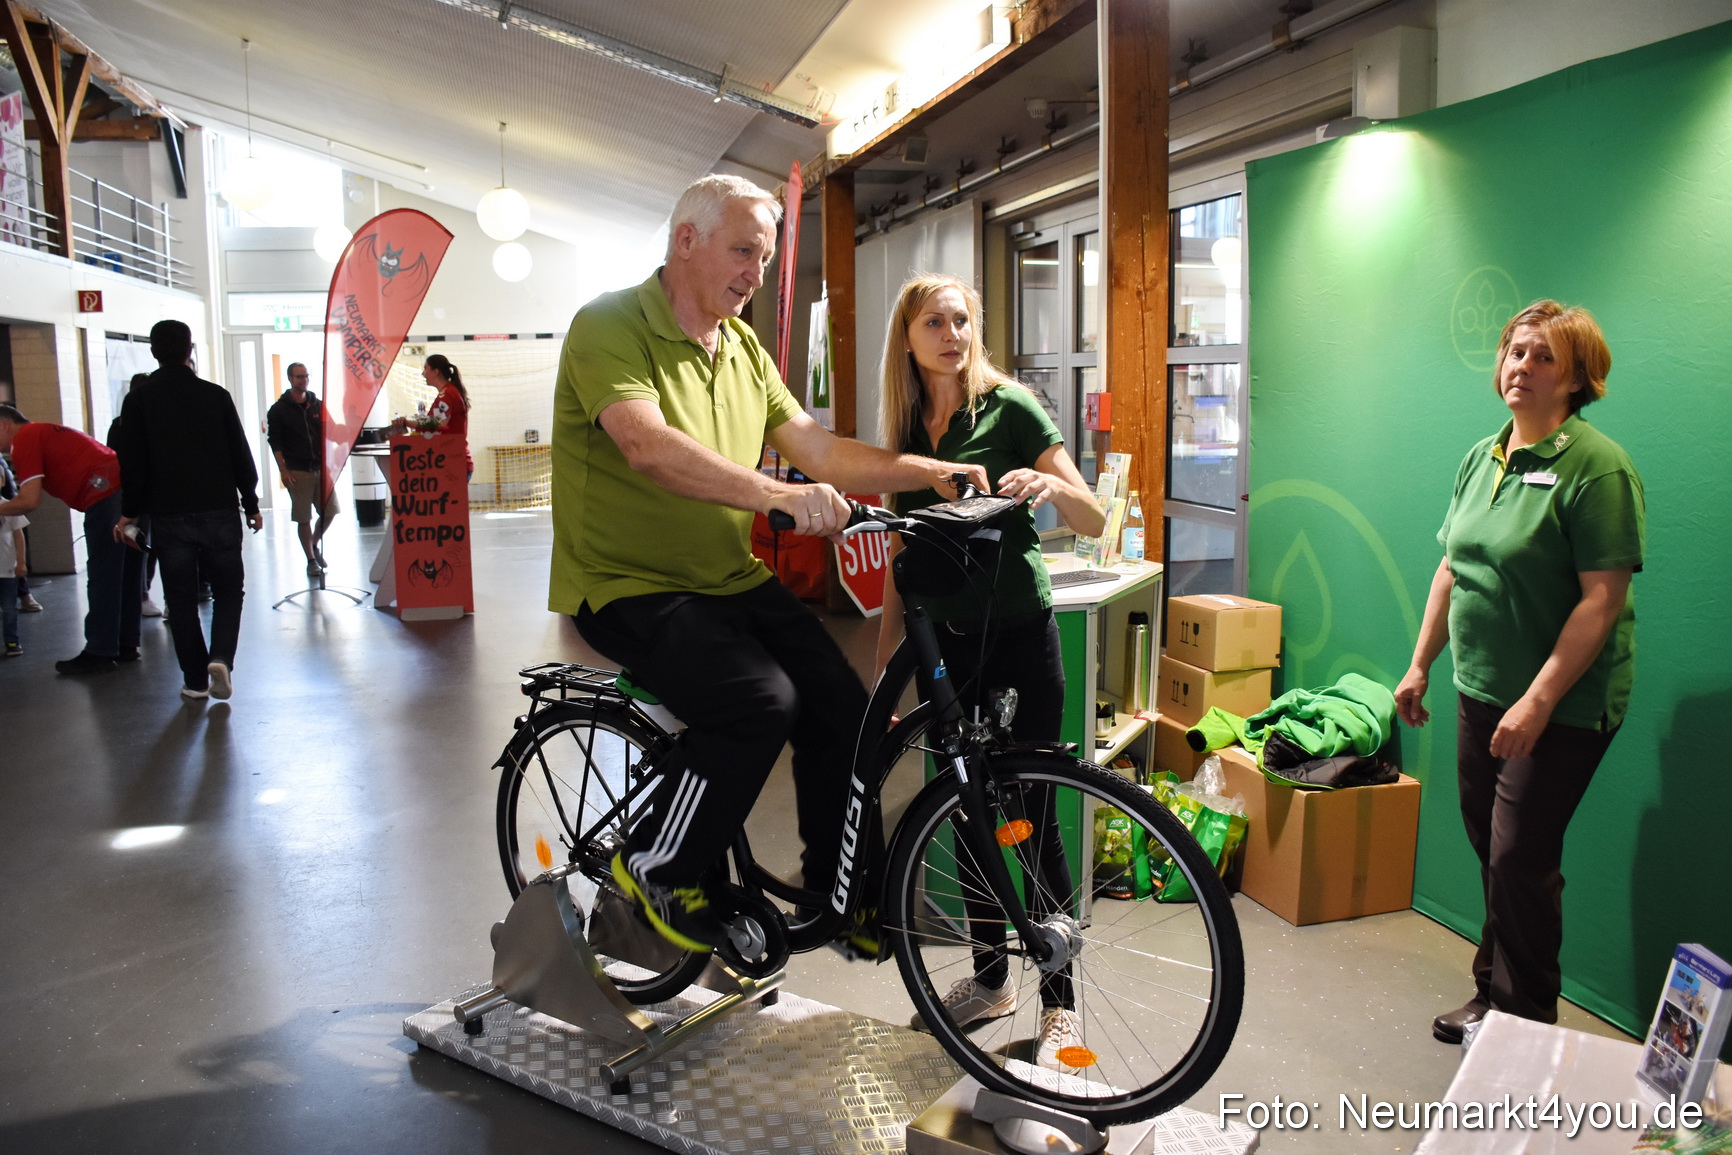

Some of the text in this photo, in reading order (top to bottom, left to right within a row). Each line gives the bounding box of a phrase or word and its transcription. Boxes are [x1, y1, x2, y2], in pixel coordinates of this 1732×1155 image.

[344, 294, 387, 357] NEUMARKT
[331, 306, 387, 379] VAMPIRES
[1553, 431, 1571, 451] AOK
[392, 444, 447, 473] Teste
[399, 473, 439, 494] dein
[392, 491, 460, 517] Wurf-
[394, 519, 466, 548] tempo
